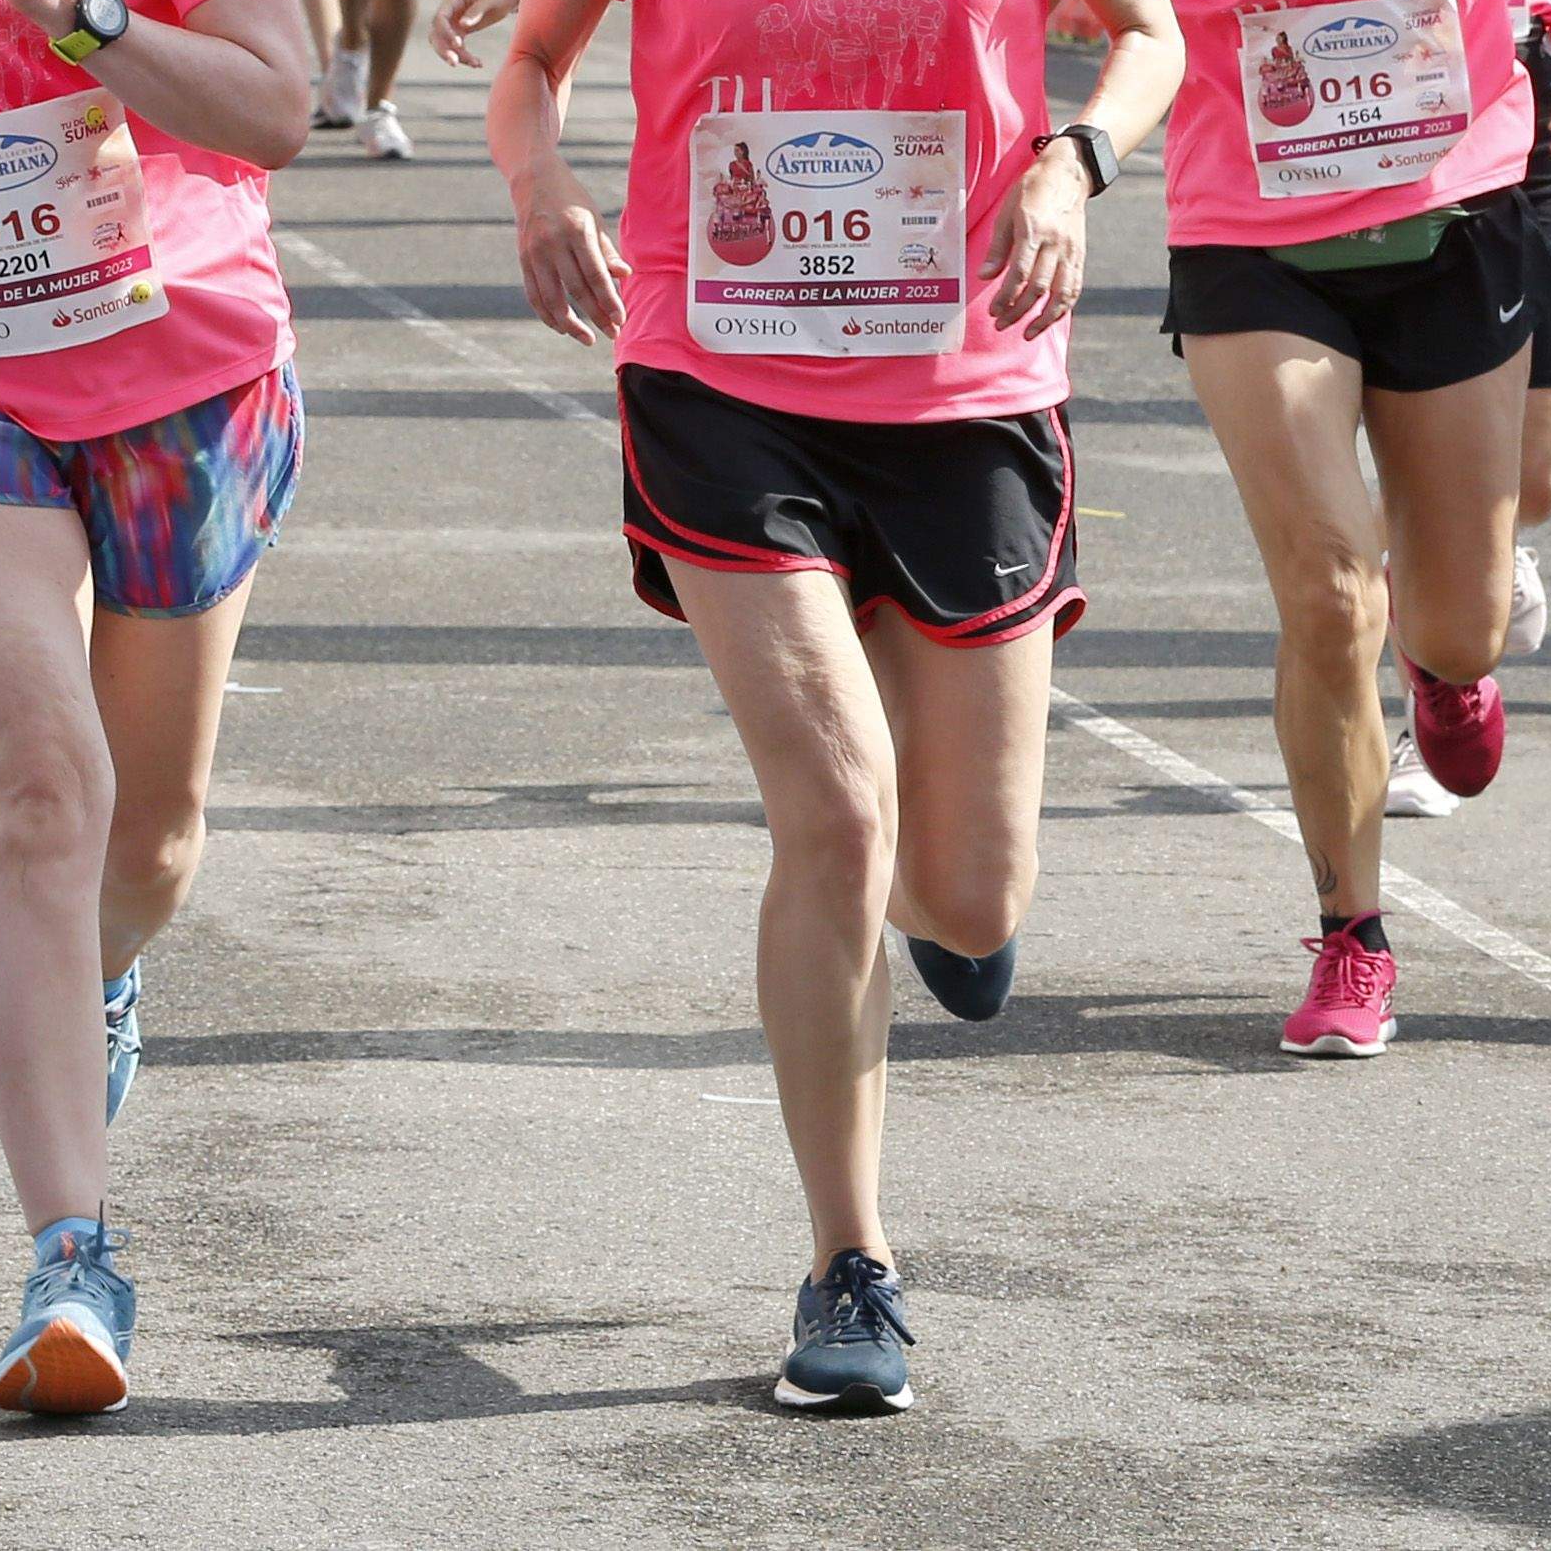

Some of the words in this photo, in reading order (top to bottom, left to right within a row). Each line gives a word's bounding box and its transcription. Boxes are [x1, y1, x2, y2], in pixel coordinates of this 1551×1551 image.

[1405, 13, 1443, 31] SUMA
[1310, 33, 1392, 54] ASTURIANA
[1319, 71, 1394, 104] 016
[1337, 106, 1383, 128] 1564
[64, 121, 110, 145] SUMA
[906, 135, 946, 143] DORSAL
[1277, 139, 1337, 157] CARRERA
[1338, 135, 1357, 148] DE
[1358, 131, 1377, 145] LA
[1376, 126, 1420, 142] MUJER
[894, 143, 946, 157] SUMA
[774, 154, 875, 175] ASTURIANA
[1278, 164, 1342, 183] OYSHO
[782, 209, 872, 242] 016
[799, 255, 856, 276] 3852
[3, 288, 24, 301] DE
[25, 285, 47, 297] LA
[49, 271, 100, 293] MUJER
[104, 258, 135, 278] 2023
[722, 287, 796, 301] CARRERA
[799, 288, 820, 300] DE
[822, 288, 848, 300] LA
[848, 287, 900, 299] MUJER
[905, 285, 940, 298] 2023
[74, 290, 139, 324] Santand
[715, 316, 797, 337] OYSHO
[864, 317, 946, 335] Santander
